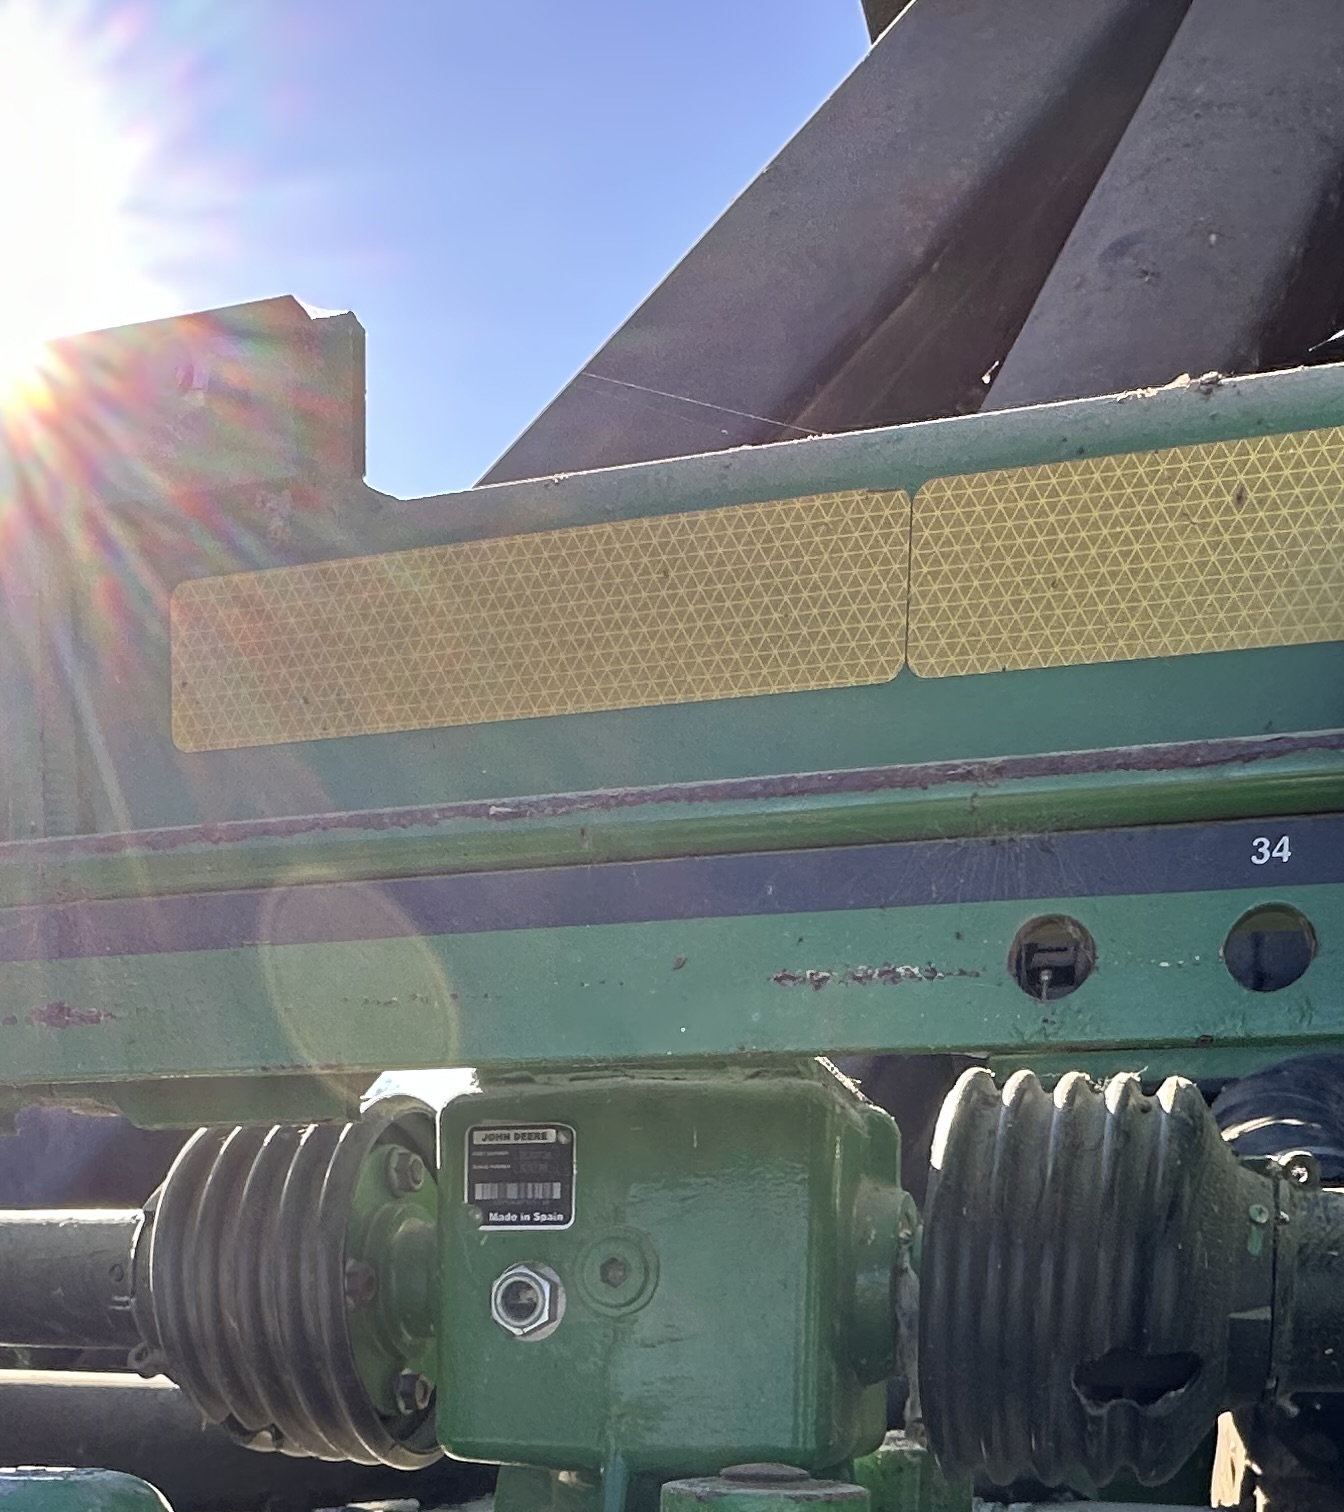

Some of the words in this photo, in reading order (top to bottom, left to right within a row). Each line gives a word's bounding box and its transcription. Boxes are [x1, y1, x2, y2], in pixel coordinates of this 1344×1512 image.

[1250, 835, 1292, 865] 34
[482, 1132, 510, 1142] JOHN
[513, 1131, 548, 1141] DEERE
[489, 1212, 518, 1221] Made
[520, 1212, 531, 1221] in
[533, 1211, 564, 1222] Spain
